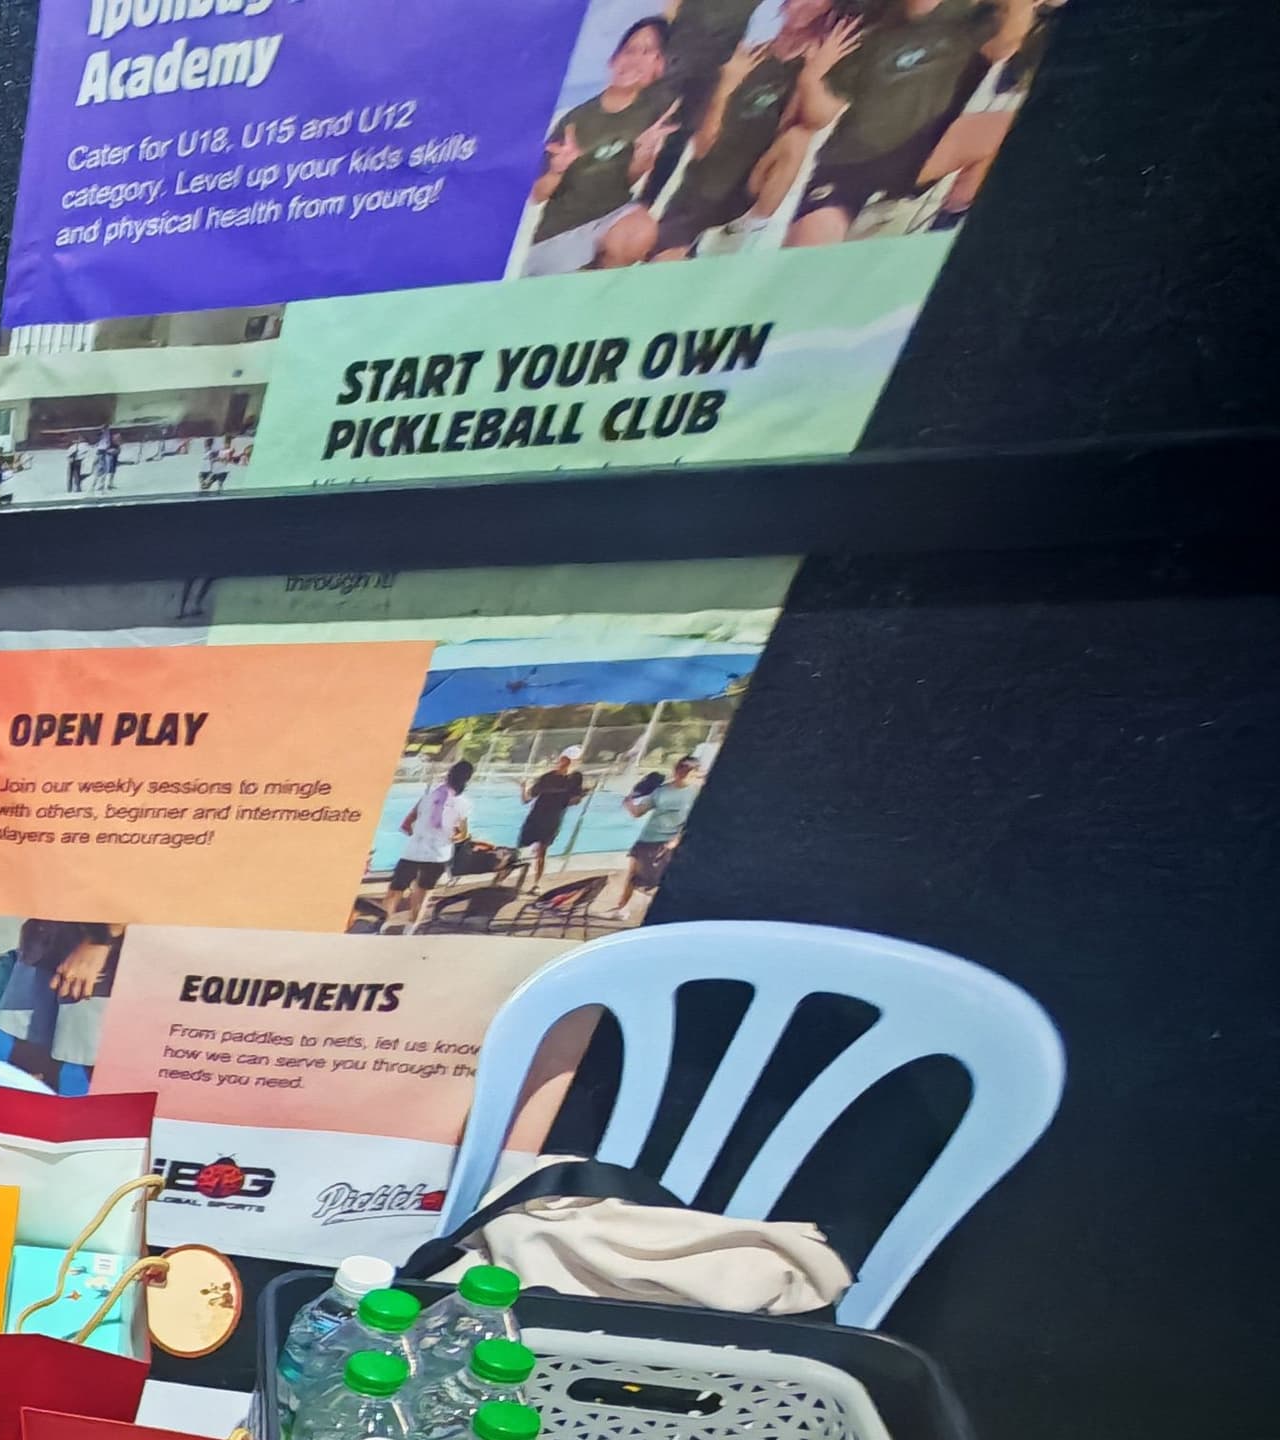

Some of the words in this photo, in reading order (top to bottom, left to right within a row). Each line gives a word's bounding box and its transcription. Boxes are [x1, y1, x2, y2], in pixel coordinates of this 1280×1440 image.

[75, 33, 284, 107] Academy
[67, 143, 135, 171] Cater
[138, 135, 174, 161] for
[241, 114, 297, 149] U15
[299, 109, 354, 141] and
[358, 99, 417, 133] U12
[61, 177, 168, 209] category.
[174, 164, 244, 196] Level
[246, 164, 280, 191] up
[283, 154, 348, 190] your
[348, 144, 403, 175] kids
[408, 130, 477, 168] skills
[55, 217, 102, 247] and
[103, 206, 203, 246] physical
[205, 199, 283, 231] health
[287, 193, 346, 222] from
[349, 176, 446, 220] young!
[336, 349, 484, 406] START
[492, 336, 632, 393] YOUR
[638, 320, 776, 378] OWN
[321, 401, 584, 461] PICKLEBALL
[598, 389, 729, 442] CLUB
[8, 712, 101, 747] OPEN
[111, 711, 209, 747] PLAY
[0, 777, 37, 794] Join
[41, 780, 75, 794] our
[77, 777, 144, 797] weekly
[146, 778, 233, 795] sessions
[239, 779, 259, 795] to
[263, 779, 332, 799] mingle
[35, 803, 98, 820] others,
[104, 803, 189, 823] beginner
[192, 804, 232, 820] and
[235, 805, 362, 823] intermediate
[60, 831, 90, 844] are
[95, 830, 216, 849] encouraged!
[179, 973, 405, 1013] EQUIPMENTS
[168, 1022, 216, 1040] From
[220, 1030, 294, 1046] paddles
[300, 1035, 317, 1047] to
[322, 1035, 367, 1051] nets,
[374, 1036, 400, 1050] let
[404, 1039, 428, 1053] us
[158, 1067, 213, 1083] needs
[216, 1073, 250, 1087] you
[254, 1076, 304, 1090] need.
[162, 1045, 203, 1060] how
[205, 1051, 232, 1063] we
[236, 1053, 270, 1065] can
[274, 1056, 326, 1069] serve
[331, 1058, 367, 1072] you
[372, 1058, 447, 1079] through
[155, 1196, 203, 1208] LOBAL
[207, 1201, 267, 1213] SPORTS
